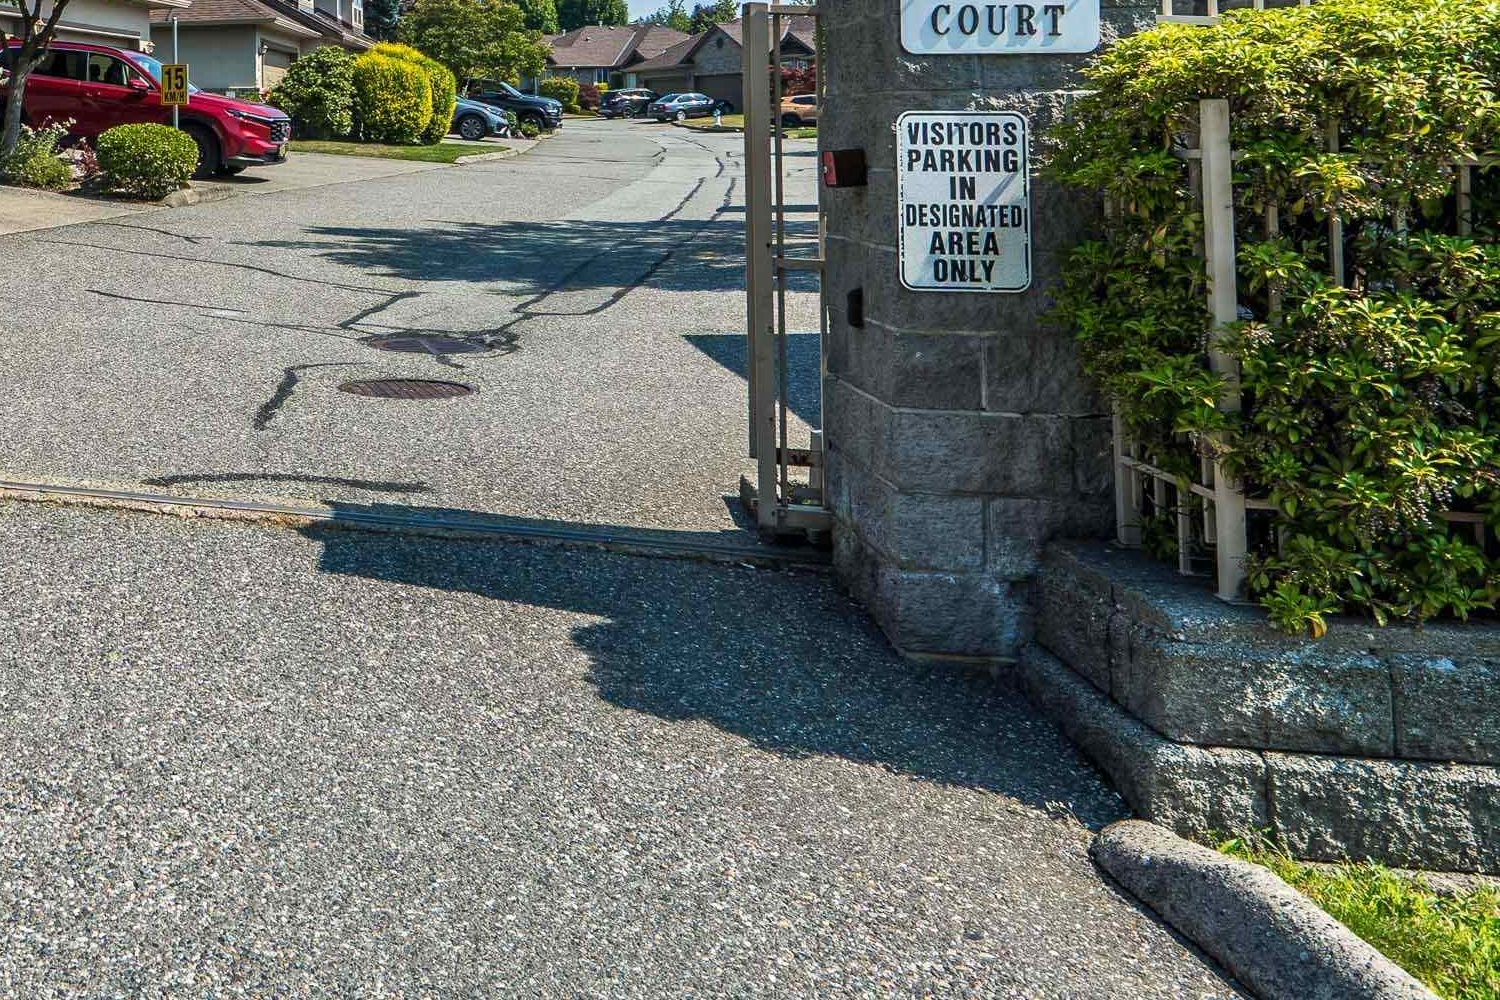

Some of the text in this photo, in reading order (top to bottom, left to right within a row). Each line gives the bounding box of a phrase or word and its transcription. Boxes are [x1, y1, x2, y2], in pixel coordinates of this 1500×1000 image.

[931, 4, 1066, 36] COURT
[165, 67, 184, 90] 15
[164, 91, 184, 102] KM/H
[907, 121, 1018, 146] VISITORS
[907, 149, 1019, 172] PARKING
[950, 176, 976, 200] IN
[905, 204, 1022, 228] DESIGNATED
[929, 231, 999, 256] AREA
[933, 259, 996, 283] ONLY
